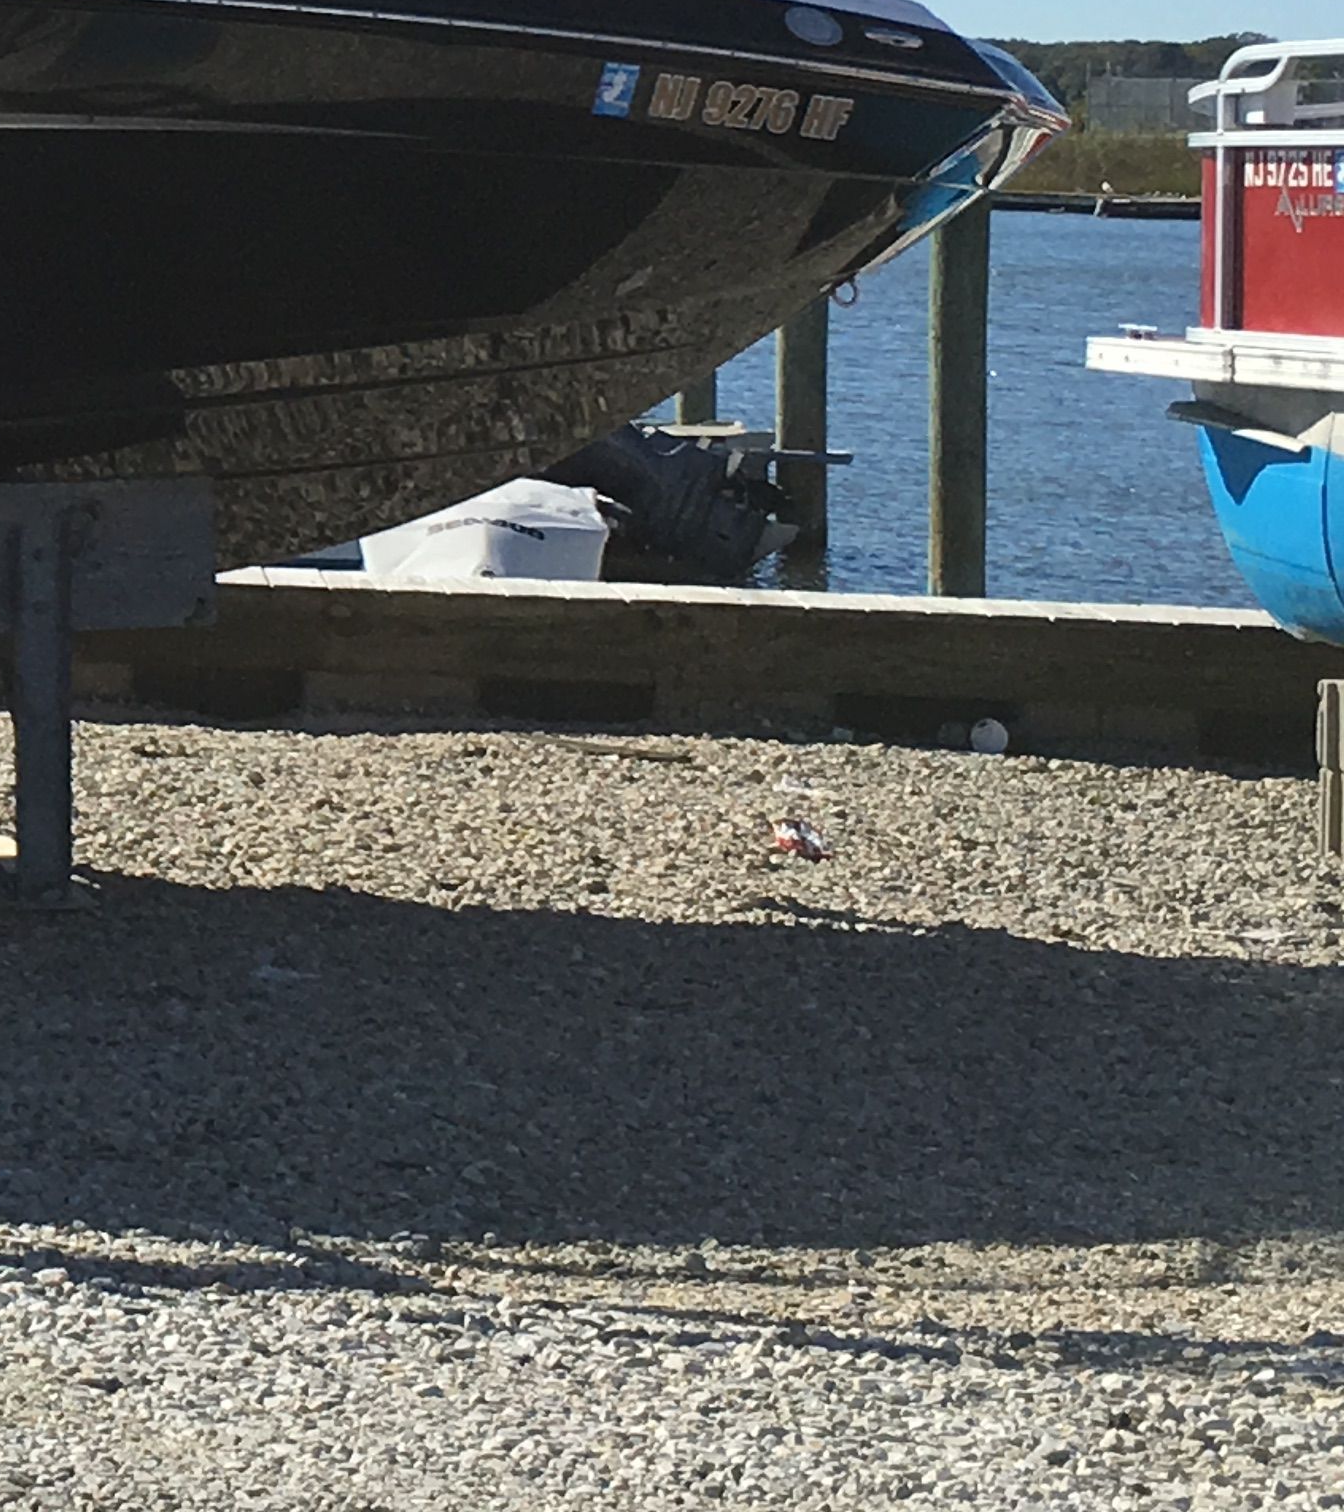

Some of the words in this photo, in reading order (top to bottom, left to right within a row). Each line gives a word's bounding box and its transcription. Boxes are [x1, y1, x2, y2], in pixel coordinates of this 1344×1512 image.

[648, 73, 702, 121] NJ
[702, 81, 800, 135] 9276
[800, 94, 855, 142] HF
[1244, 150, 1265, 187] NJ
[1312, 150, 1334, 187] HE
